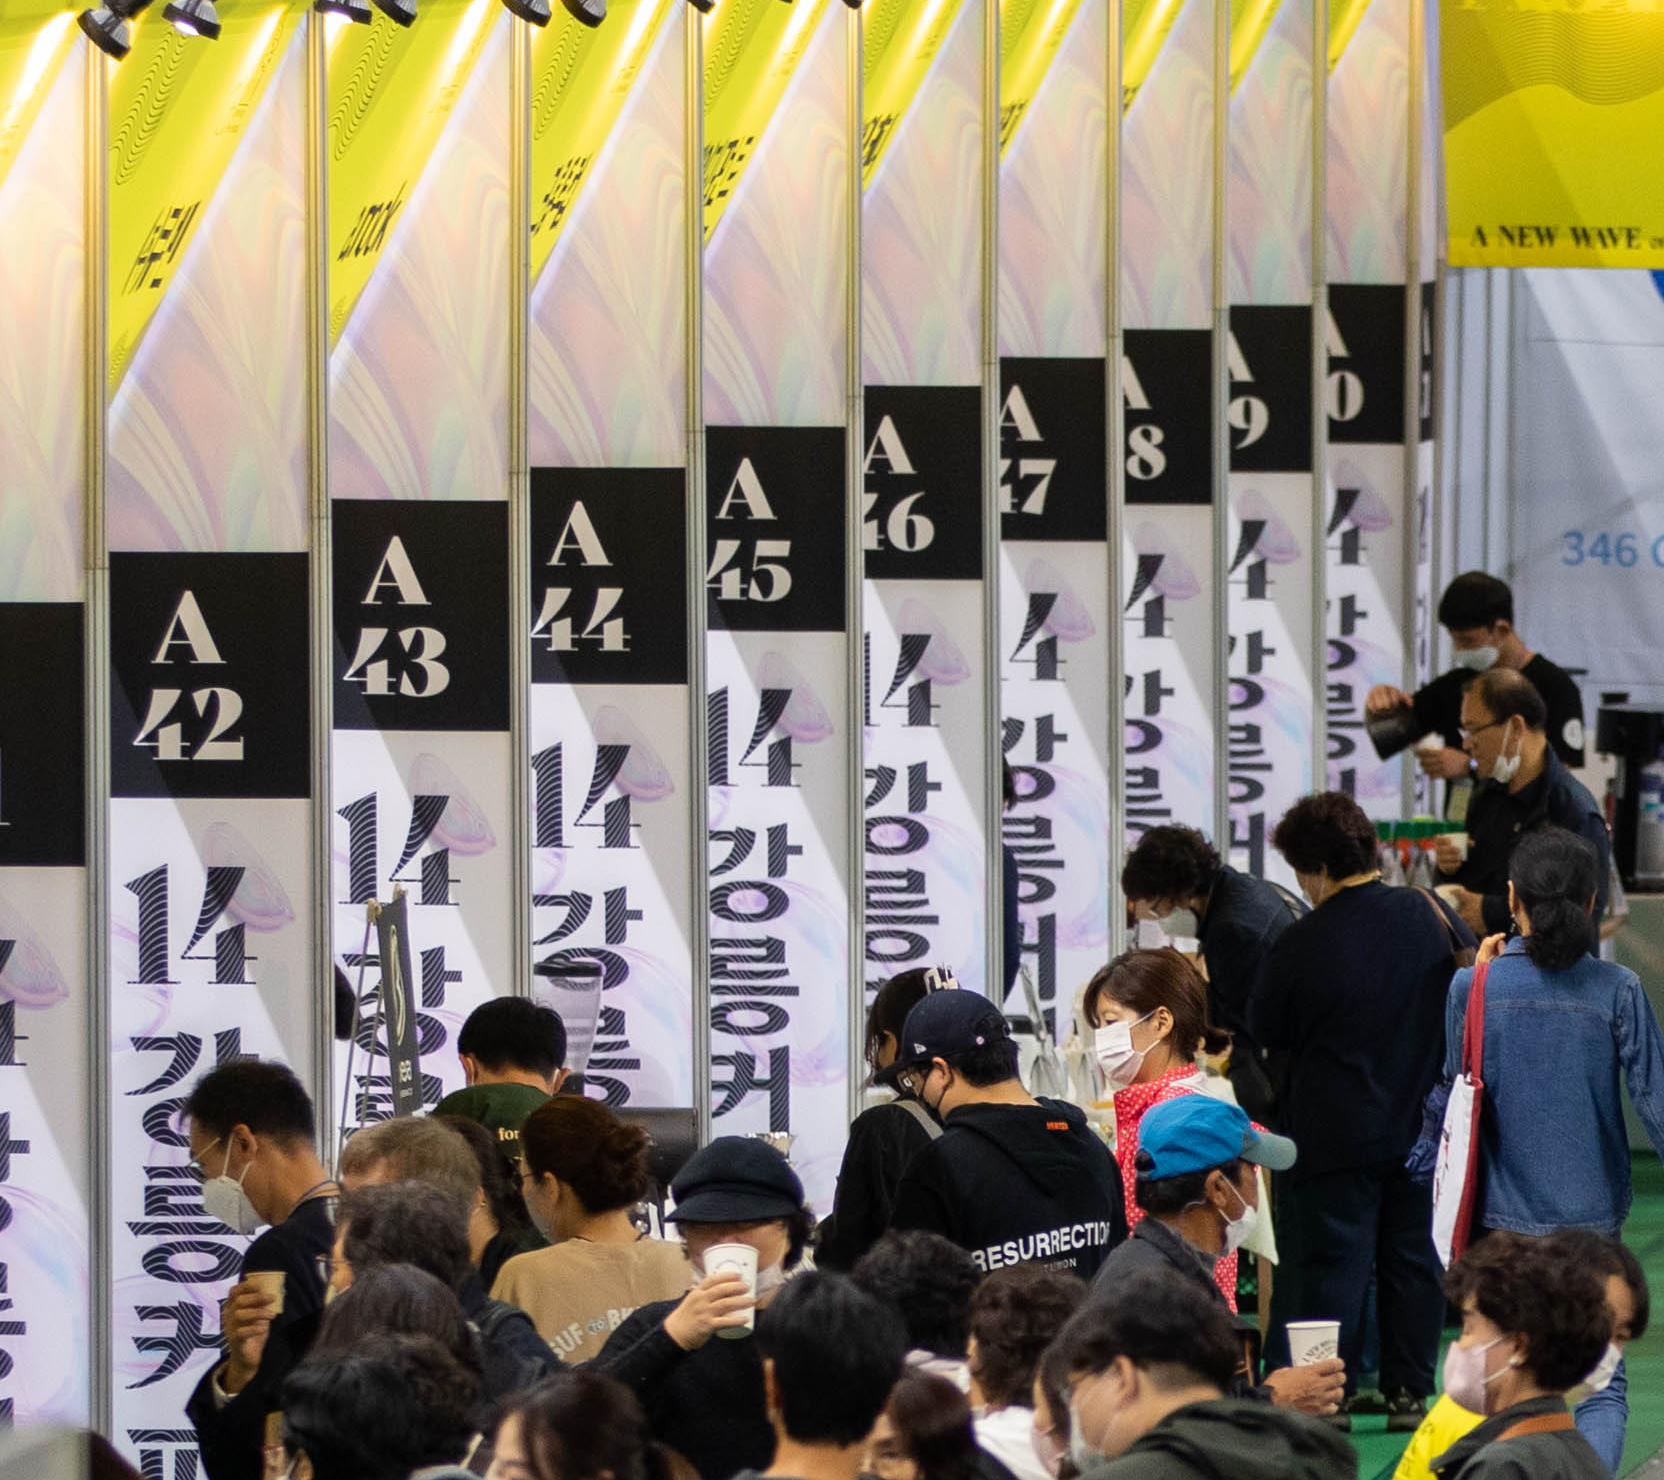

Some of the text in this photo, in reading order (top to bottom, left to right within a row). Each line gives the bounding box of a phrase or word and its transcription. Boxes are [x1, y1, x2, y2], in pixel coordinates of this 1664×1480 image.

[1470, 223, 1489, 248] A
[1497, 223, 1559, 249] NEW
[1571, 224, 1643, 251] WAVE
[864, 414, 915, 474] A
[1001, 383, 1044, 442] A
[714, 456, 778, 520] A
[545, 500, 614, 568] A
[1561, 529, 1639, 568] 346
[360, 534, 431, 606] A
[707, 538, 795, 601] 45
[153, 589, 228, 666] A
[532, 587, 632, 653] 44
[343, 626, 451, 699] 43
[133, 688, 246, 763] 42
[709, 687, 803, 788] 14
[532, 743, 643, 849] 14
[336, 793, 462, 907] 14
[123, 865, 260, 988] 14
